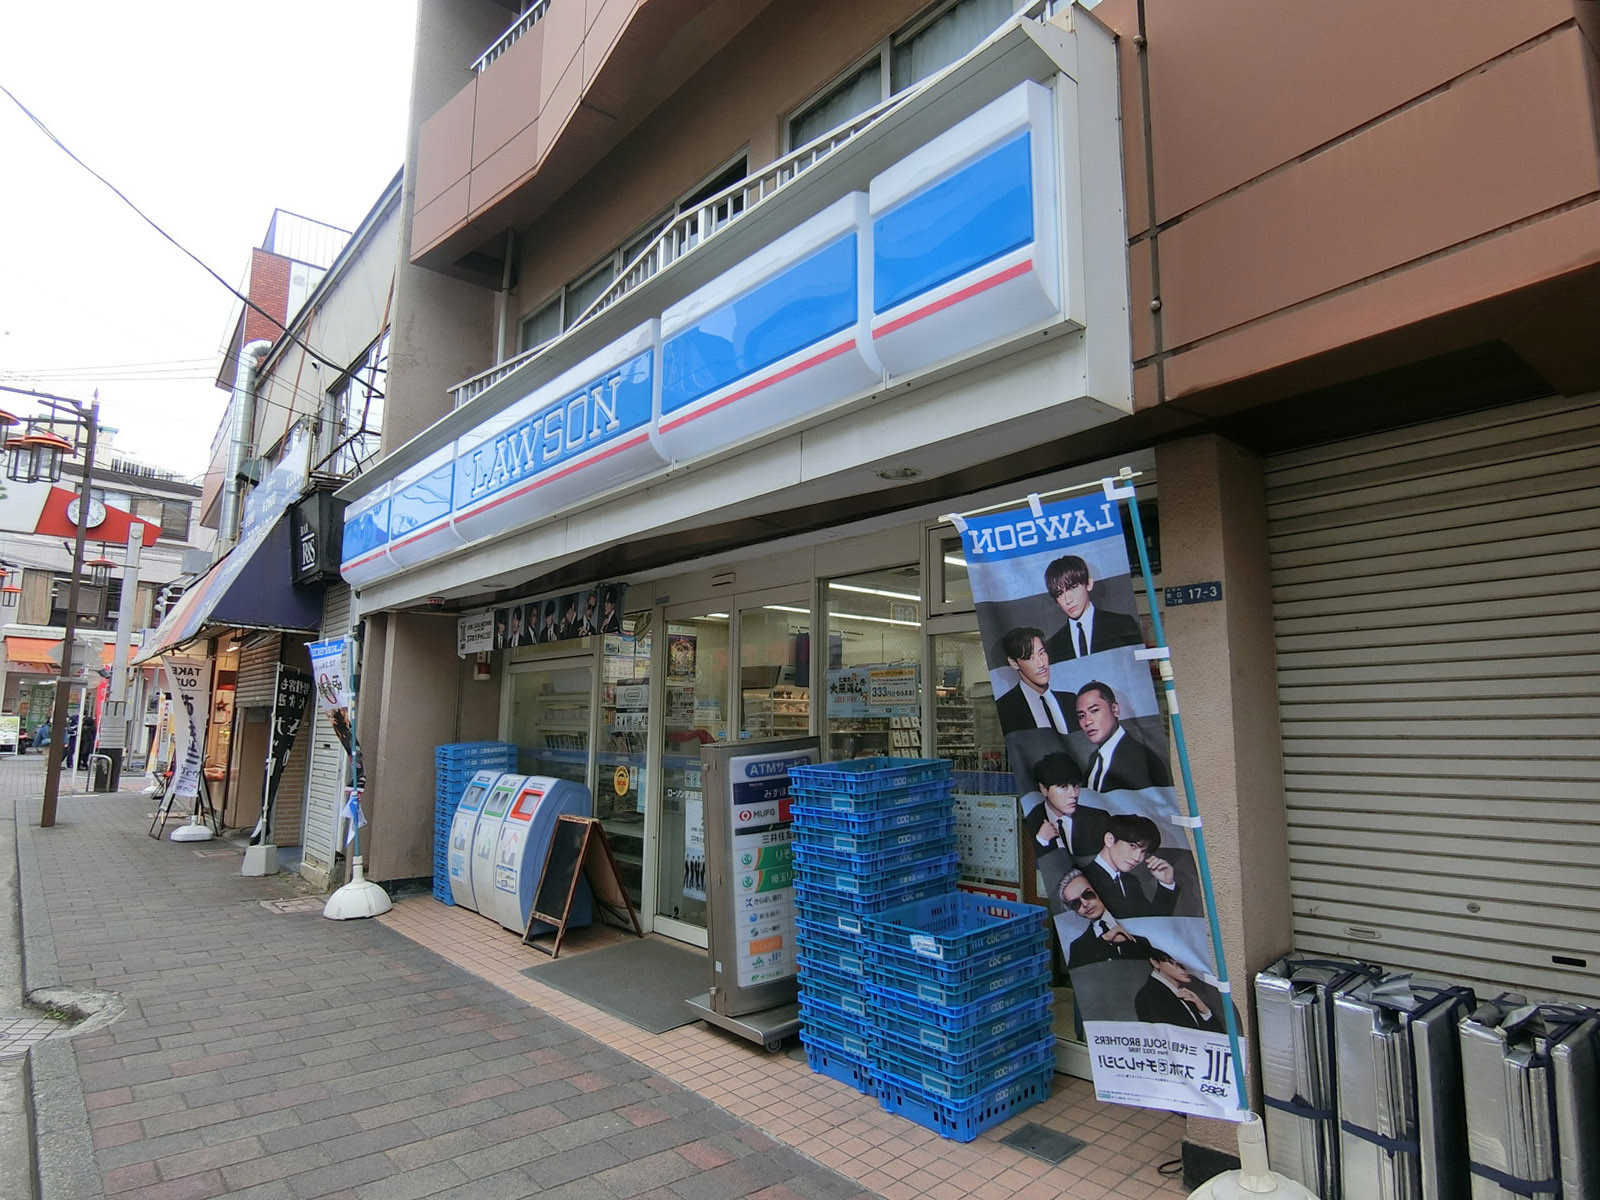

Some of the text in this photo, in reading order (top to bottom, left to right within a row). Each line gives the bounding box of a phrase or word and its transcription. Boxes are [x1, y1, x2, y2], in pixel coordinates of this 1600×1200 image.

[470, 370, 622, 498] LAWSON
[1188, 585, 1217, 600] 17-3
[750, 758, 808, 776] ATMサービス
[753, 808, 776, 819] MUFG
[762, 831, 795, 845] 三井住友
